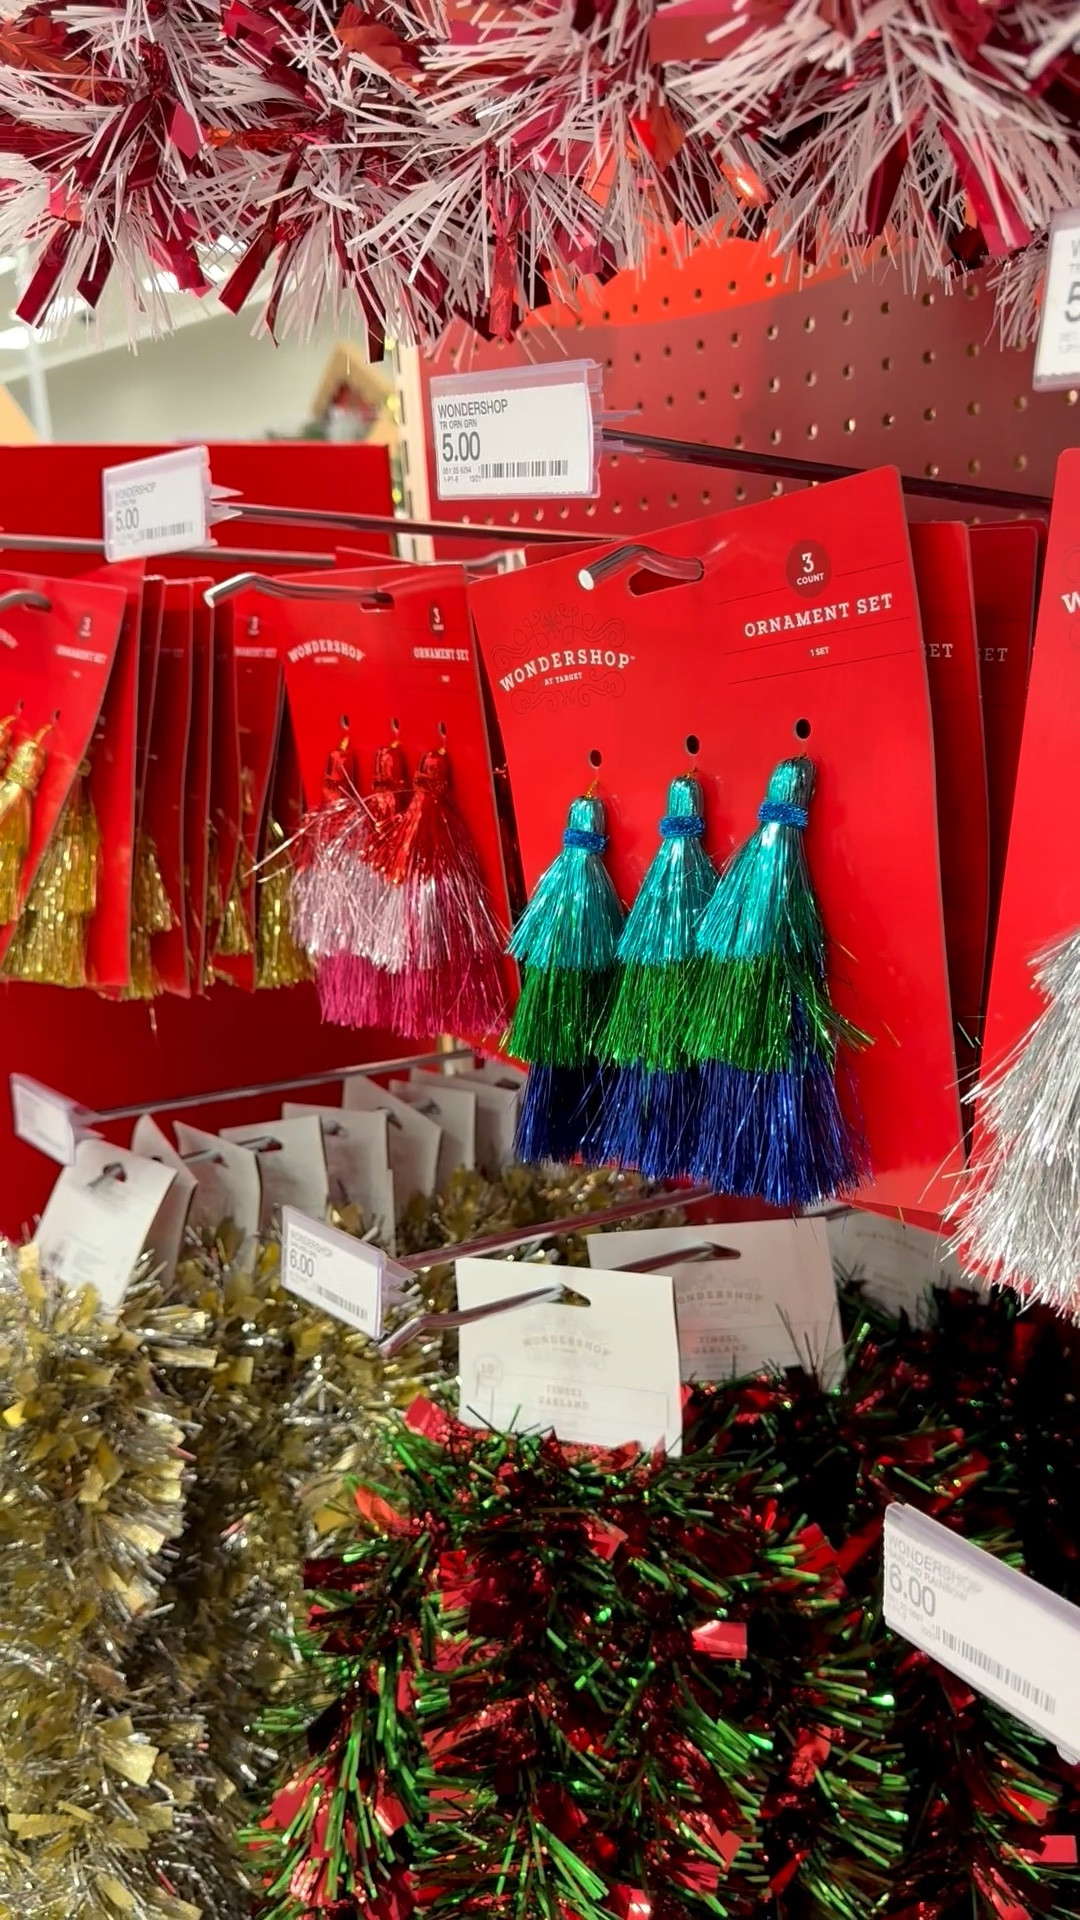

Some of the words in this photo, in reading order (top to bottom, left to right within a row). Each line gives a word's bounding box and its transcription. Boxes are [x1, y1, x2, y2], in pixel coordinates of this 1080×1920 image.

[437, 399, 508, 419] WONDERSHOP
[439, 421, 448, 430] TR
[449, 420, 463, 429] ORN
[464, 419, 478, 428] GRN
[442, 431, 481, 462] 5.00
[115, 507, 139, 531] 5.00
[802, 552, 815, 573] 3
[797, 573, 825, 586] COUNT
[432, 607, 441, 623] 3
[744, 602, 850, 638] ORNAMENT
[856, 594, 893, 616] SET
[287, 639, 366, 664] WONDERSHOP
[413, 646, 455, 660] ORNAMENT
[456, 648, 470, 661] SET
[815, 646, 830, 656] SET
[500, 649, 630, 692] WONDERSHOP
[544, 678, 554, 686] AT
[556, 672, 583, 684] TARGET
[290, 1248, 315, 1278] 6.00
[677, 1290, 765, 1305] ONDERSHOP
[522, 1334, 611, 1356] WONDERSHOP
[889, 1563, 936, 1618] 6.00
